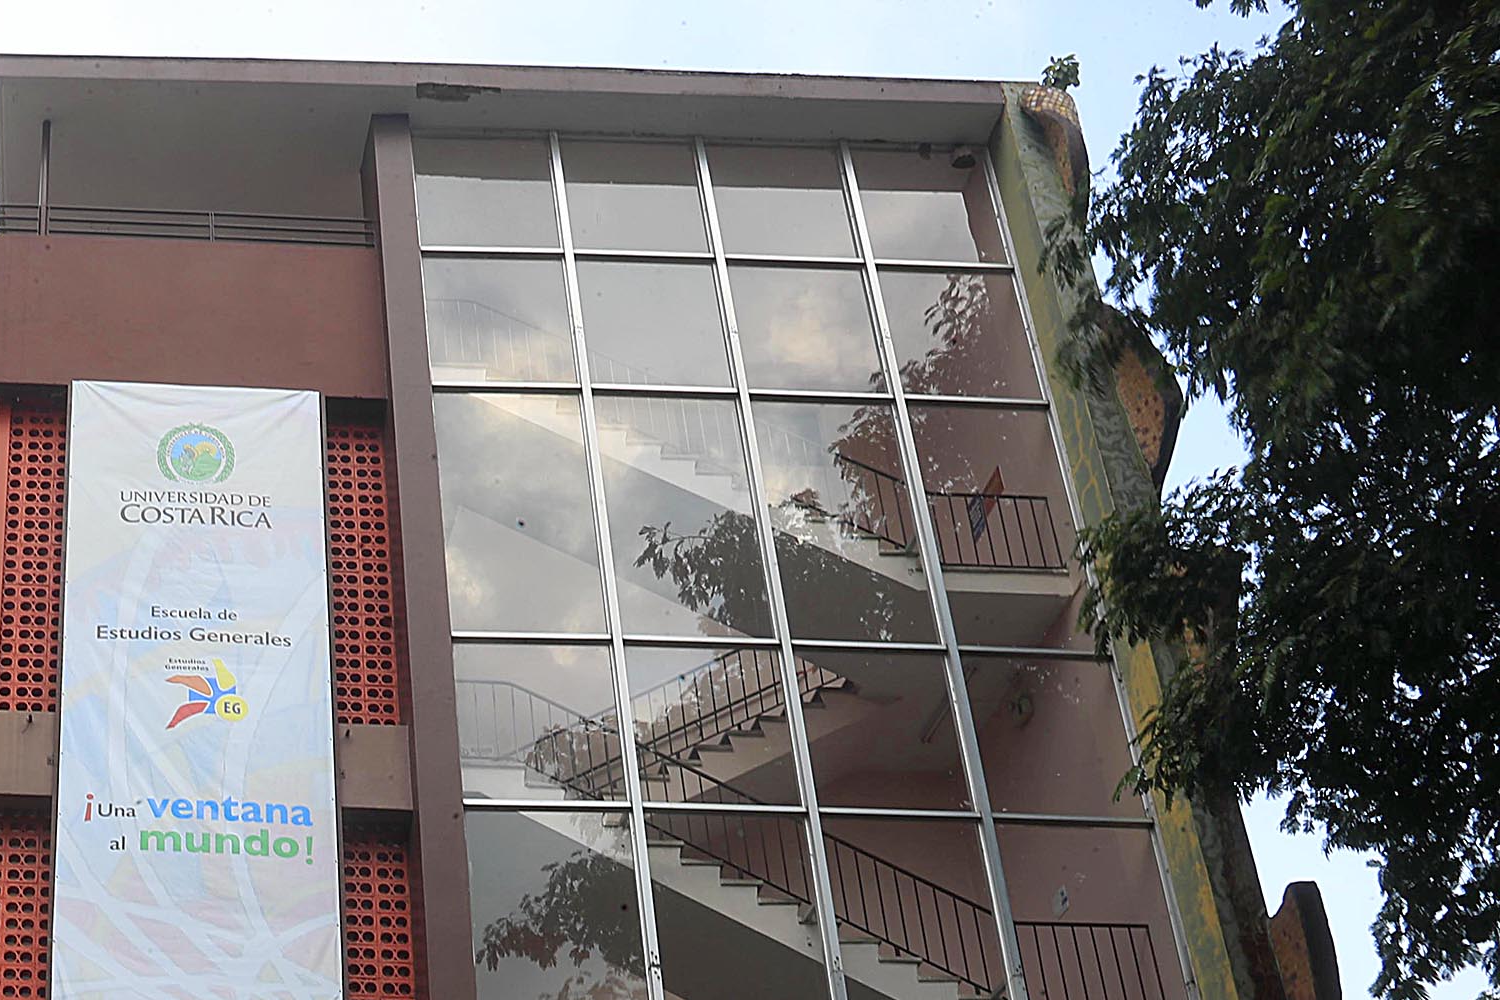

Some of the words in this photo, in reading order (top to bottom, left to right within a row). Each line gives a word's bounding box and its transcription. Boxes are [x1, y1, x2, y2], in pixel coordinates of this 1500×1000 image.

[120, 490, 243, 506] UNIVERSIDAD
[248, 495, 272, 508] DE
[120, 503, 205, 525] COSTA
[209, 506, 273, 529] RICA
[150, 605, 212, 620] Escuela
[217, 608, 238, 621] de
[96, 624, 182, 641] Estudios
[189, 627, 292, 648] Generales
[168, 657, 206, 665] Estudios
[223, 701, 242, 715] EG
[147, 795, 313, 827] ventana
[109, 835, 127, 851] al
[139, 828, 314, 865] mundo!
